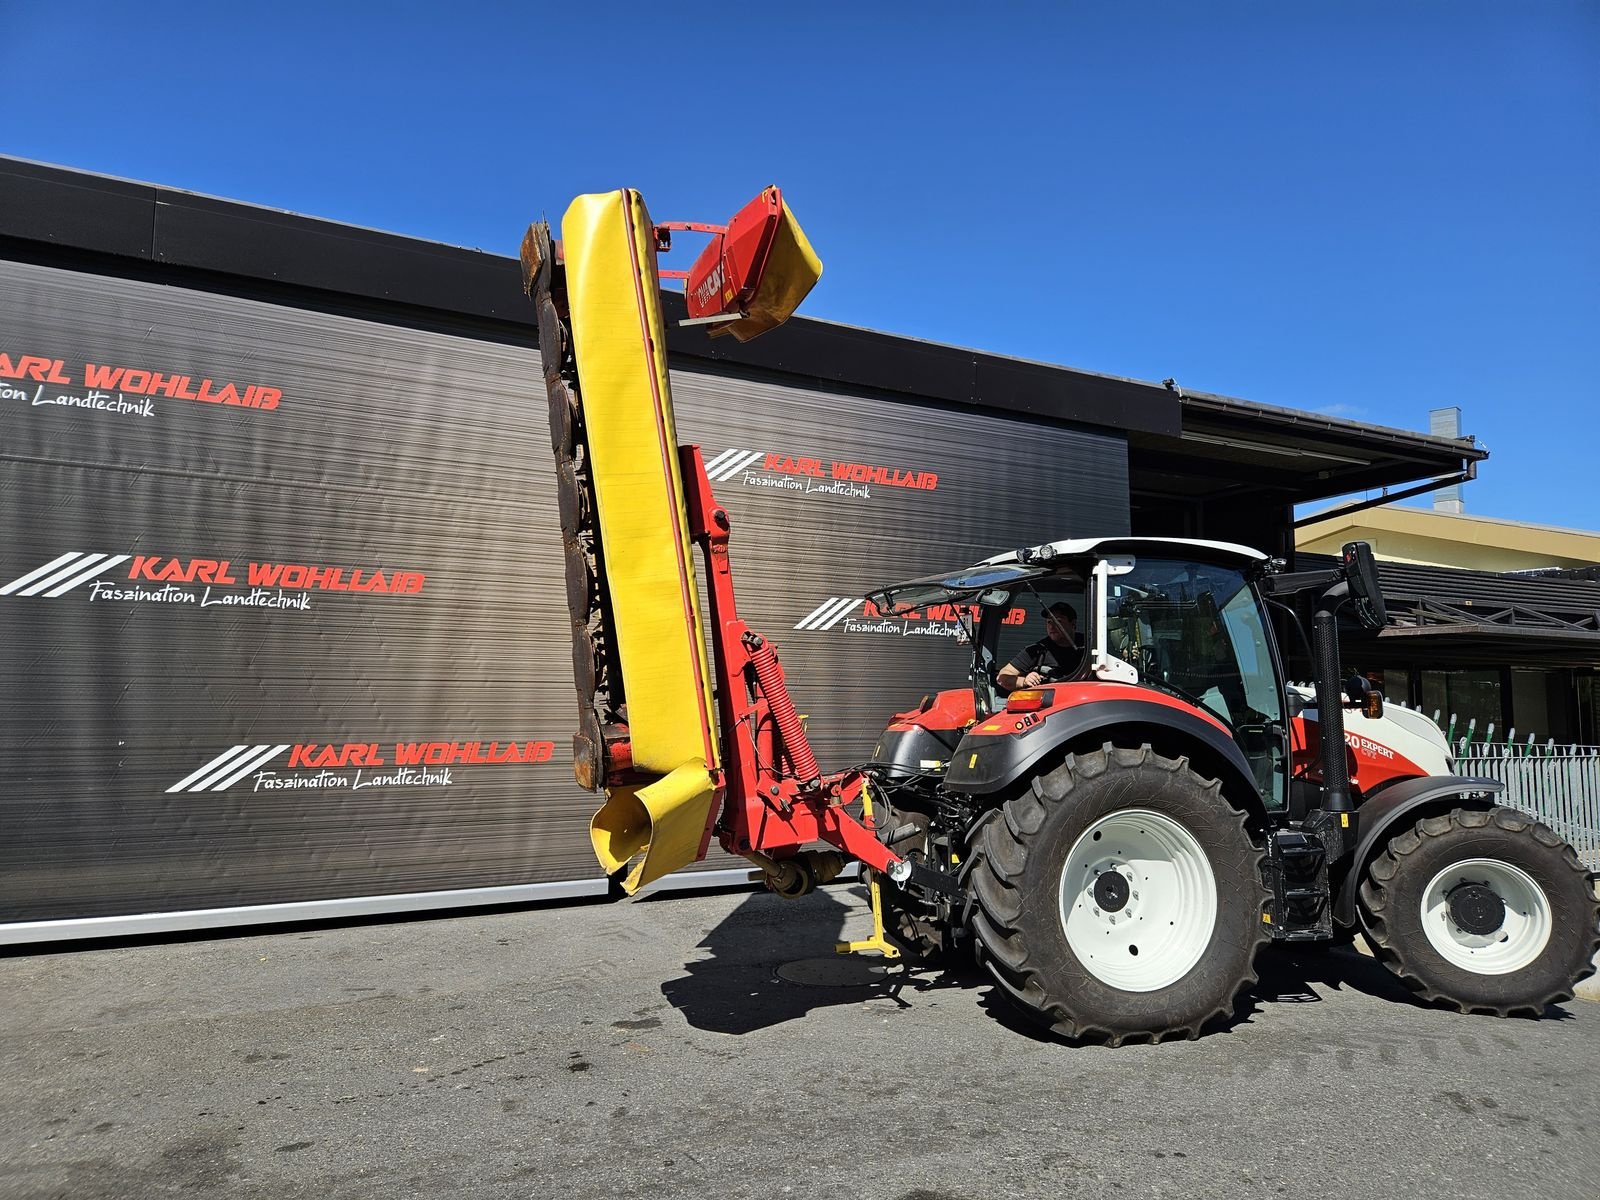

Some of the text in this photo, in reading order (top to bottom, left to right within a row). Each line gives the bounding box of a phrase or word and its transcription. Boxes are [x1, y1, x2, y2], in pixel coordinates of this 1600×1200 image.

[0, 353, 283, 410] ARL WOHLLAIB
[32, 384, 155, 417] Landtechnik
[742, 470, 871, 499] Faszination Landtechnik
[763, 453, 939, 491] KARL WOHLLAIB
[128, 555, 426, 594] KARL WOHLLAIB
[89, 580, 311, 611] Faszination Landtechnik
[843, 618, 901, 634] Faszination
[288, 741, 555, 768] KARL WOHLLAIB
[1361, 738, 1395, 760] EXPERT
[252, 768, 453, 793] Faszination Landtechnik
